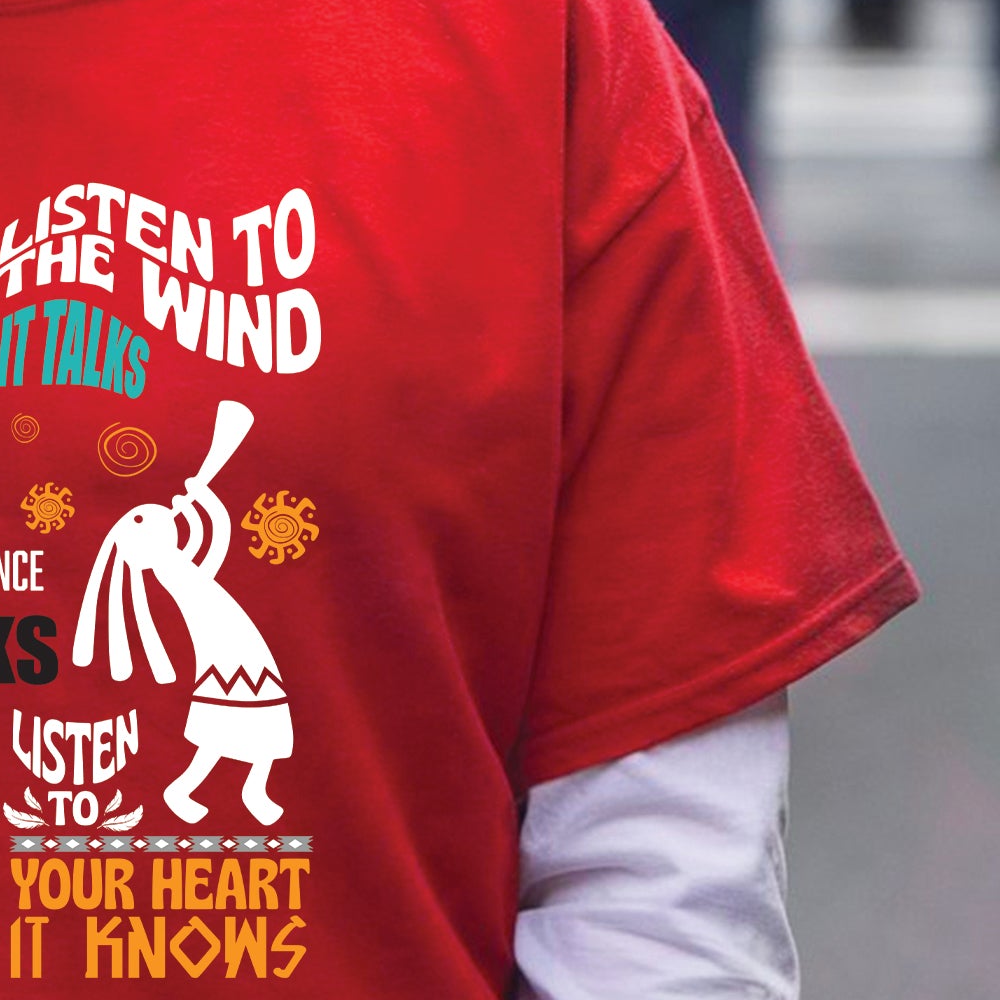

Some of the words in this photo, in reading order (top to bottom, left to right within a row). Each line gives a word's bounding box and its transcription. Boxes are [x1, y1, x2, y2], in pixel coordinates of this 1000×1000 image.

[232, 188, 316, 287] TO
[41, 299, 150, 399] TALKS
[142, 257, 322, 375] WIND
[12, 708, 139, 785] LISTEN
[47, 790, 99, 826] TO
[10, 858, 135, 910] YOUR
[151, 858, 311, 910] HEART
[10, 916, 50, 979] IT
[84, 915, 307, 979] KNOWS
